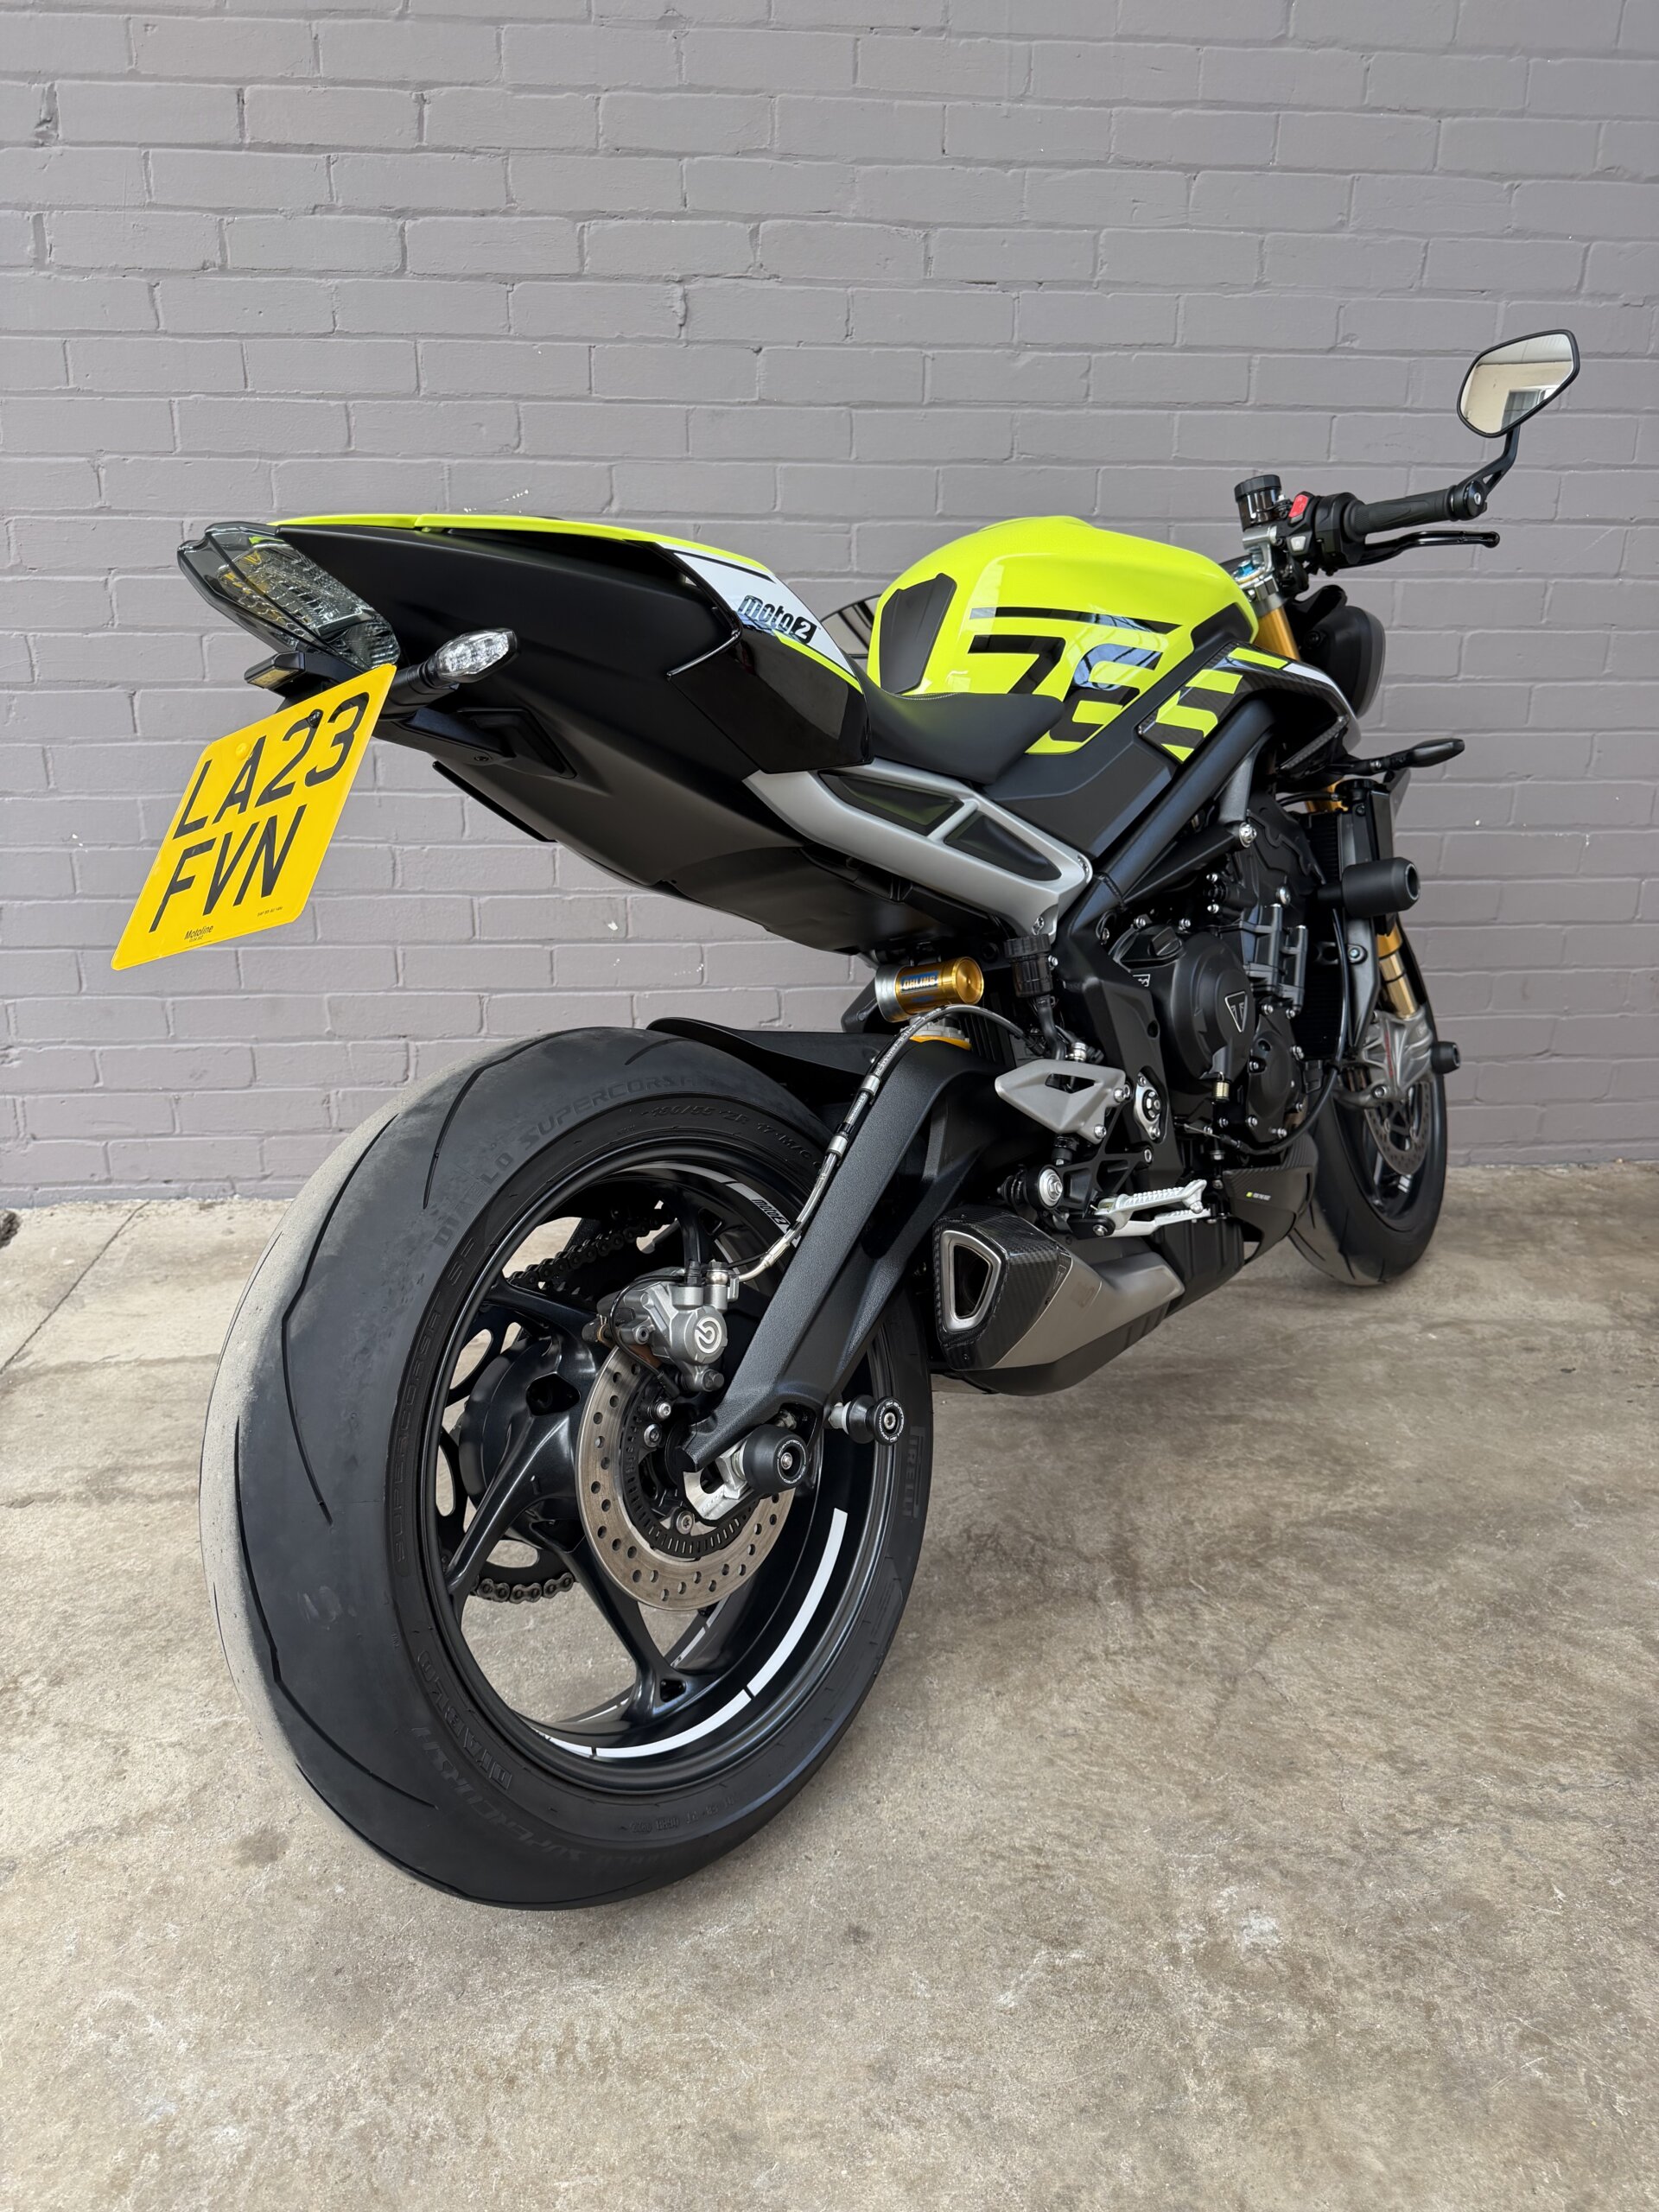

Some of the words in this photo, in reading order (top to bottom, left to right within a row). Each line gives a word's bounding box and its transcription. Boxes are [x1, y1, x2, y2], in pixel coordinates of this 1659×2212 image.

[738, 594, 817, 645] moto2
[172, 691, 370, 840] LA23
[149, 804, 308, 933] FVN
[184, 925, 214, 941] Motoline
[417, 1650, 513, 1791] DIABLO
